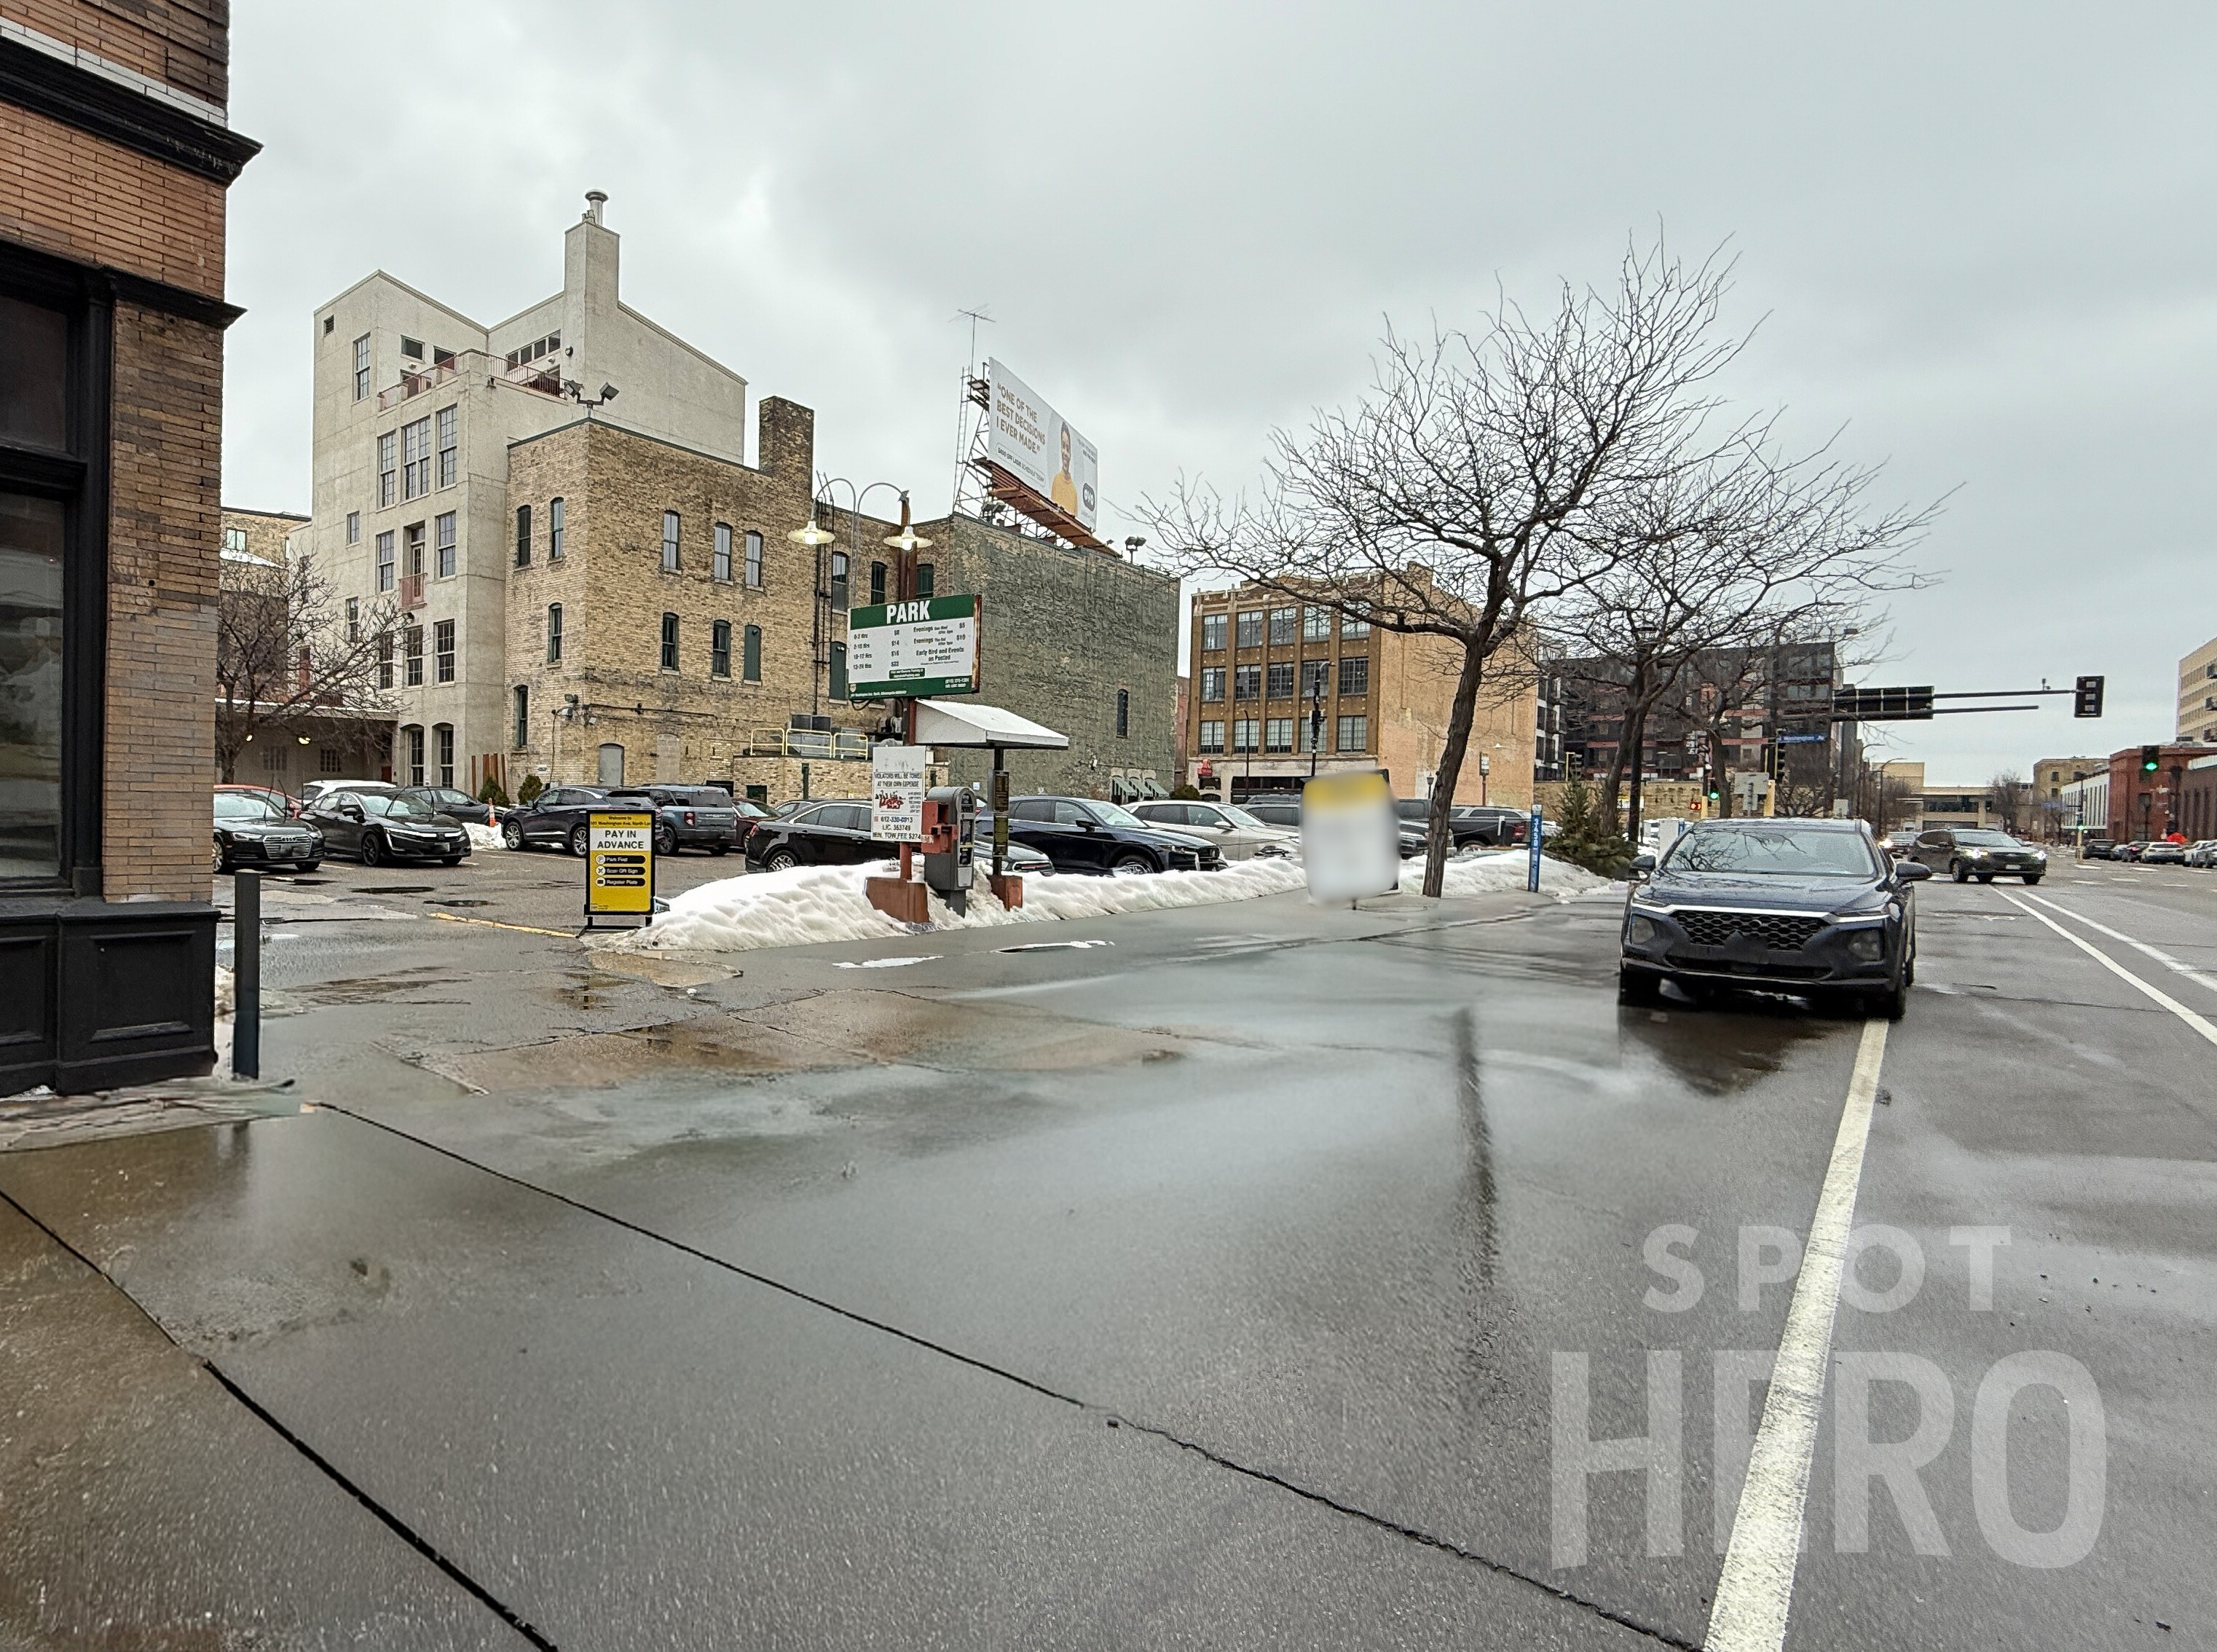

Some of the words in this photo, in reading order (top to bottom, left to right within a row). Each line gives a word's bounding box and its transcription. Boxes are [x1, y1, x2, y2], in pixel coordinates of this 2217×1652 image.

[997, 399, 1015, 421] BEST
[1015, 412, 1045, 445] DECISIONS
[1017, 398, 1025, 412] OF
[1025, 403, 1037, 423] THE
[996, 415, 999, 428] I
[1000, 419, 1017, 442] EVER
[886, 599, 930, 624] PARK
[597, 841, 644, 849] ADVANCE
[605, 830, 625, 838] PAY
